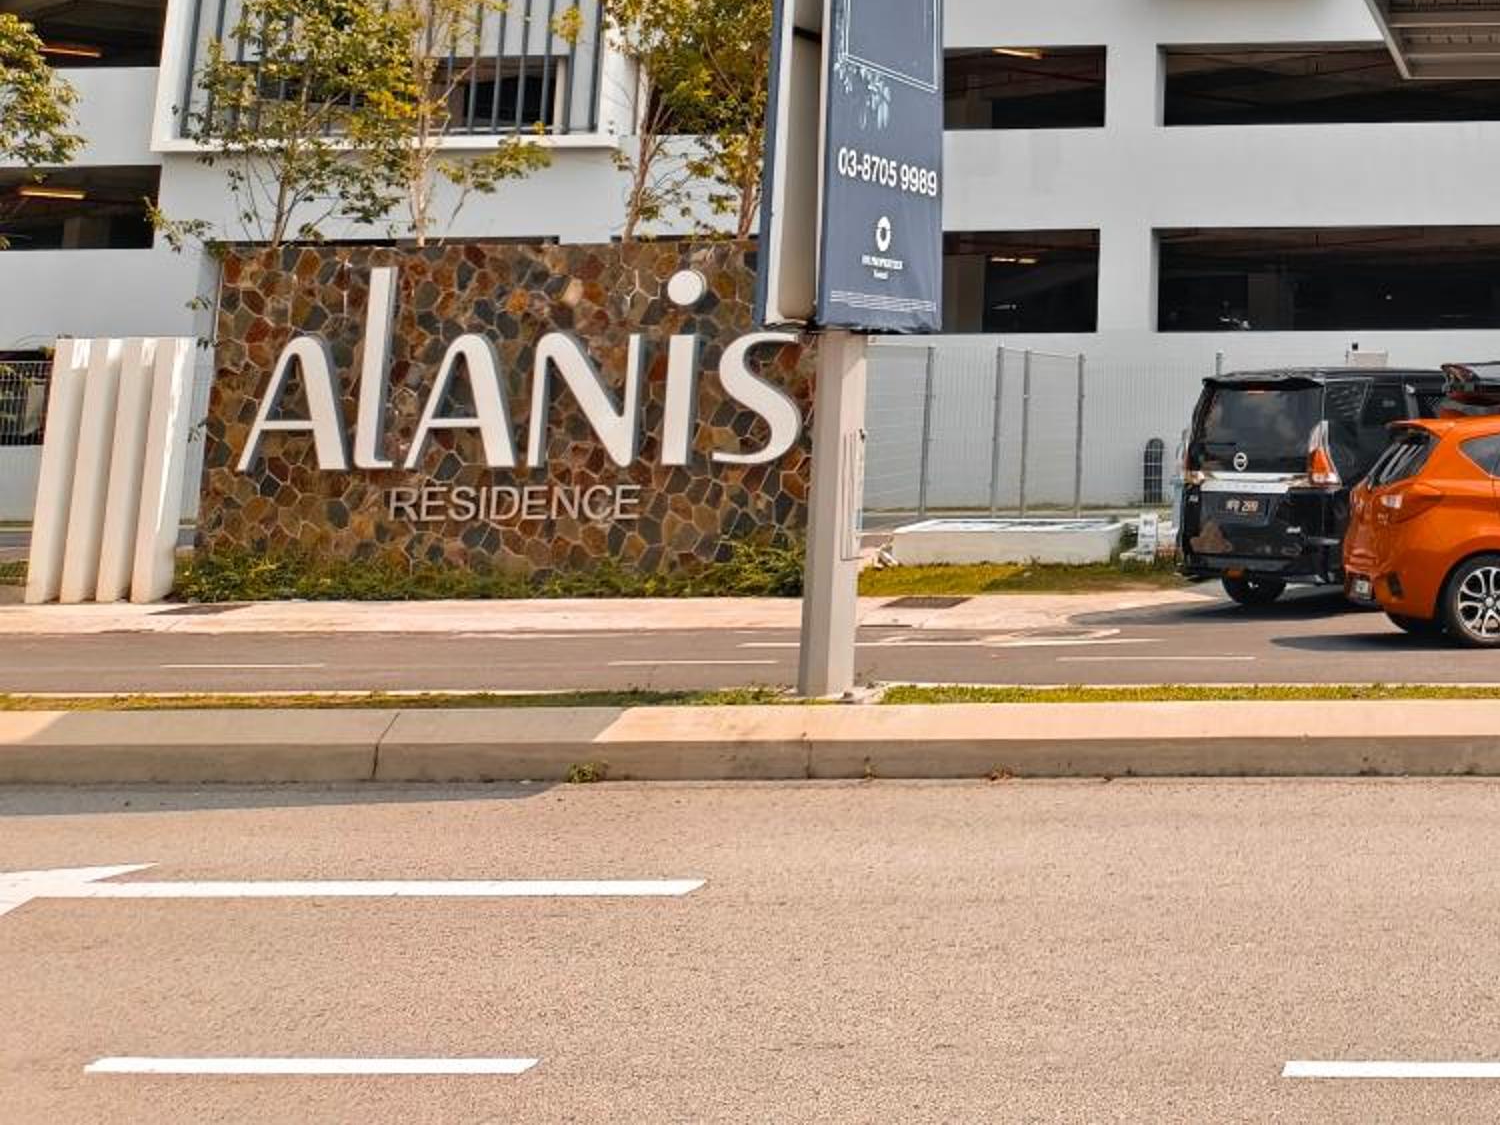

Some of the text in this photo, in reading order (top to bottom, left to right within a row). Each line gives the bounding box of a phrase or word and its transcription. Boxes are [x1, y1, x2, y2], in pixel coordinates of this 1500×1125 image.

[838, 147, 937, 197] 03-8705 9989
[388, 484, 642, 524] RESIDENCE
